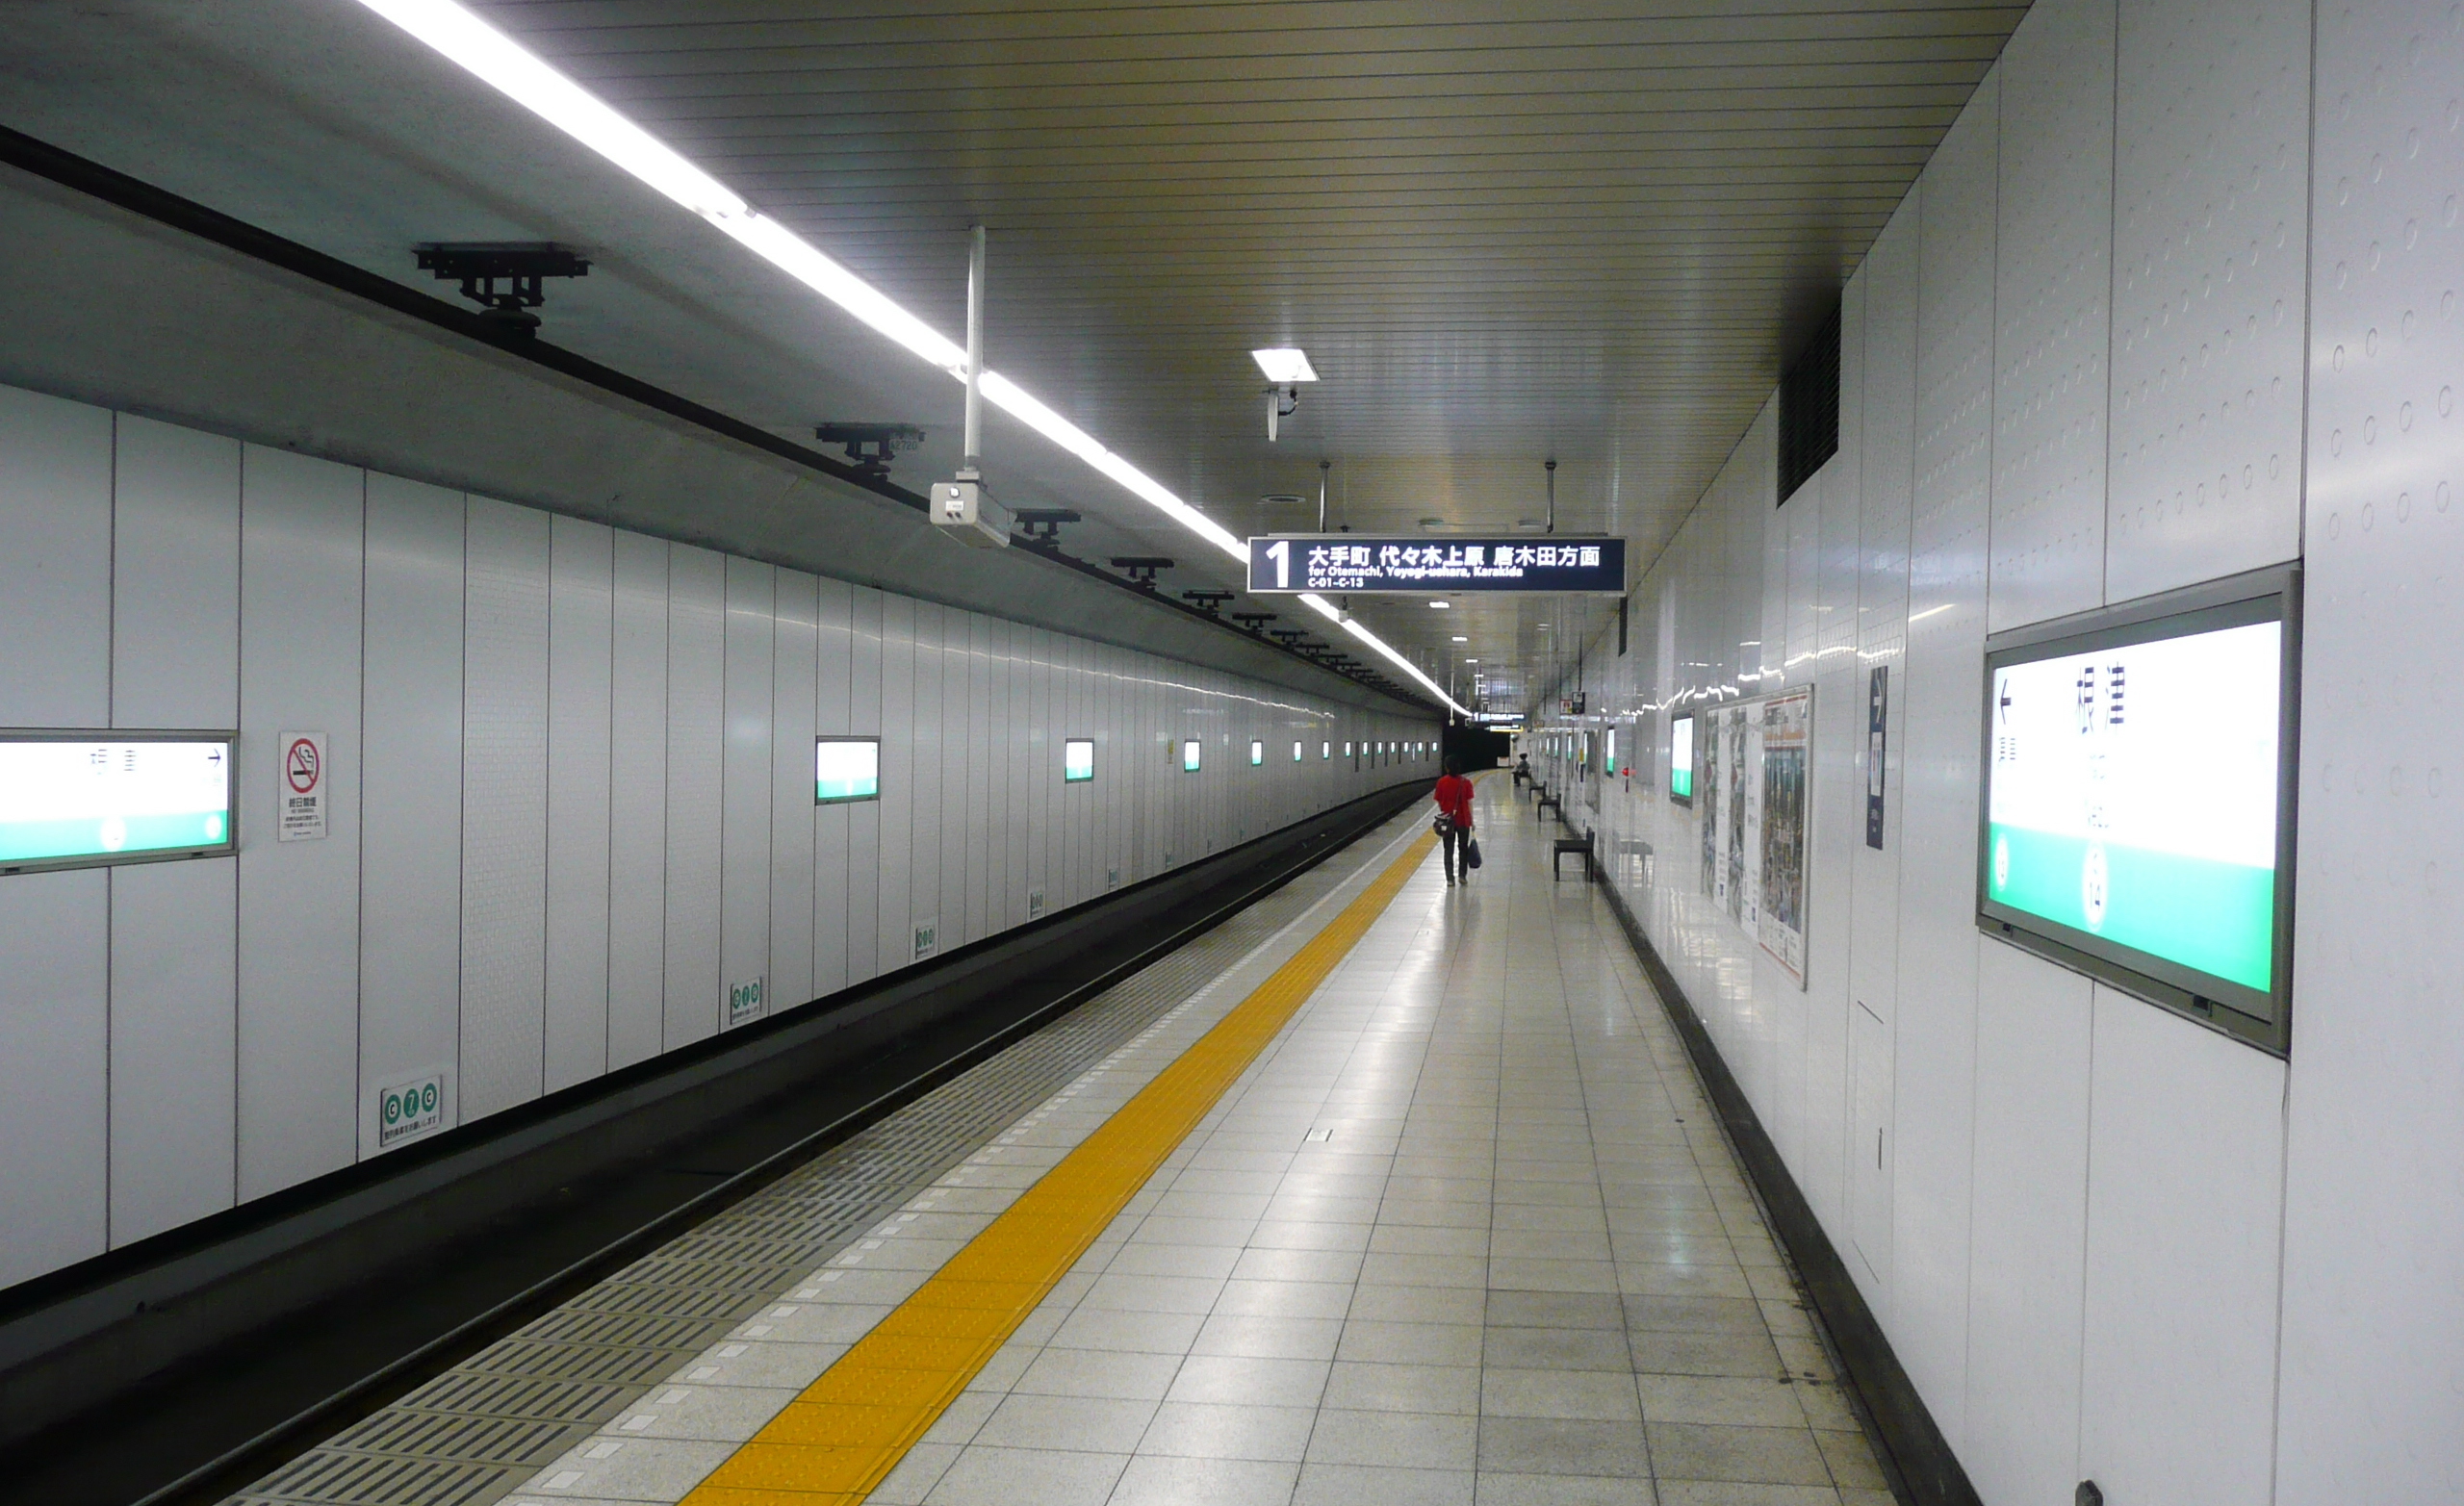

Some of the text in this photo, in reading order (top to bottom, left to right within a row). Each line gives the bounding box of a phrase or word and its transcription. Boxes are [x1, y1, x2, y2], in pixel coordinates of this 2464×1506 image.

[1266, 541, 1289, 588] 1
[1308, 545, 1601, 567] 大手町 代々木上原 唐木田方面
[1308, 566, 1326, 576] for
[1328, 566, 1383, 578] Otemachi,
[1474, 566, 1524, 577] Karakida
